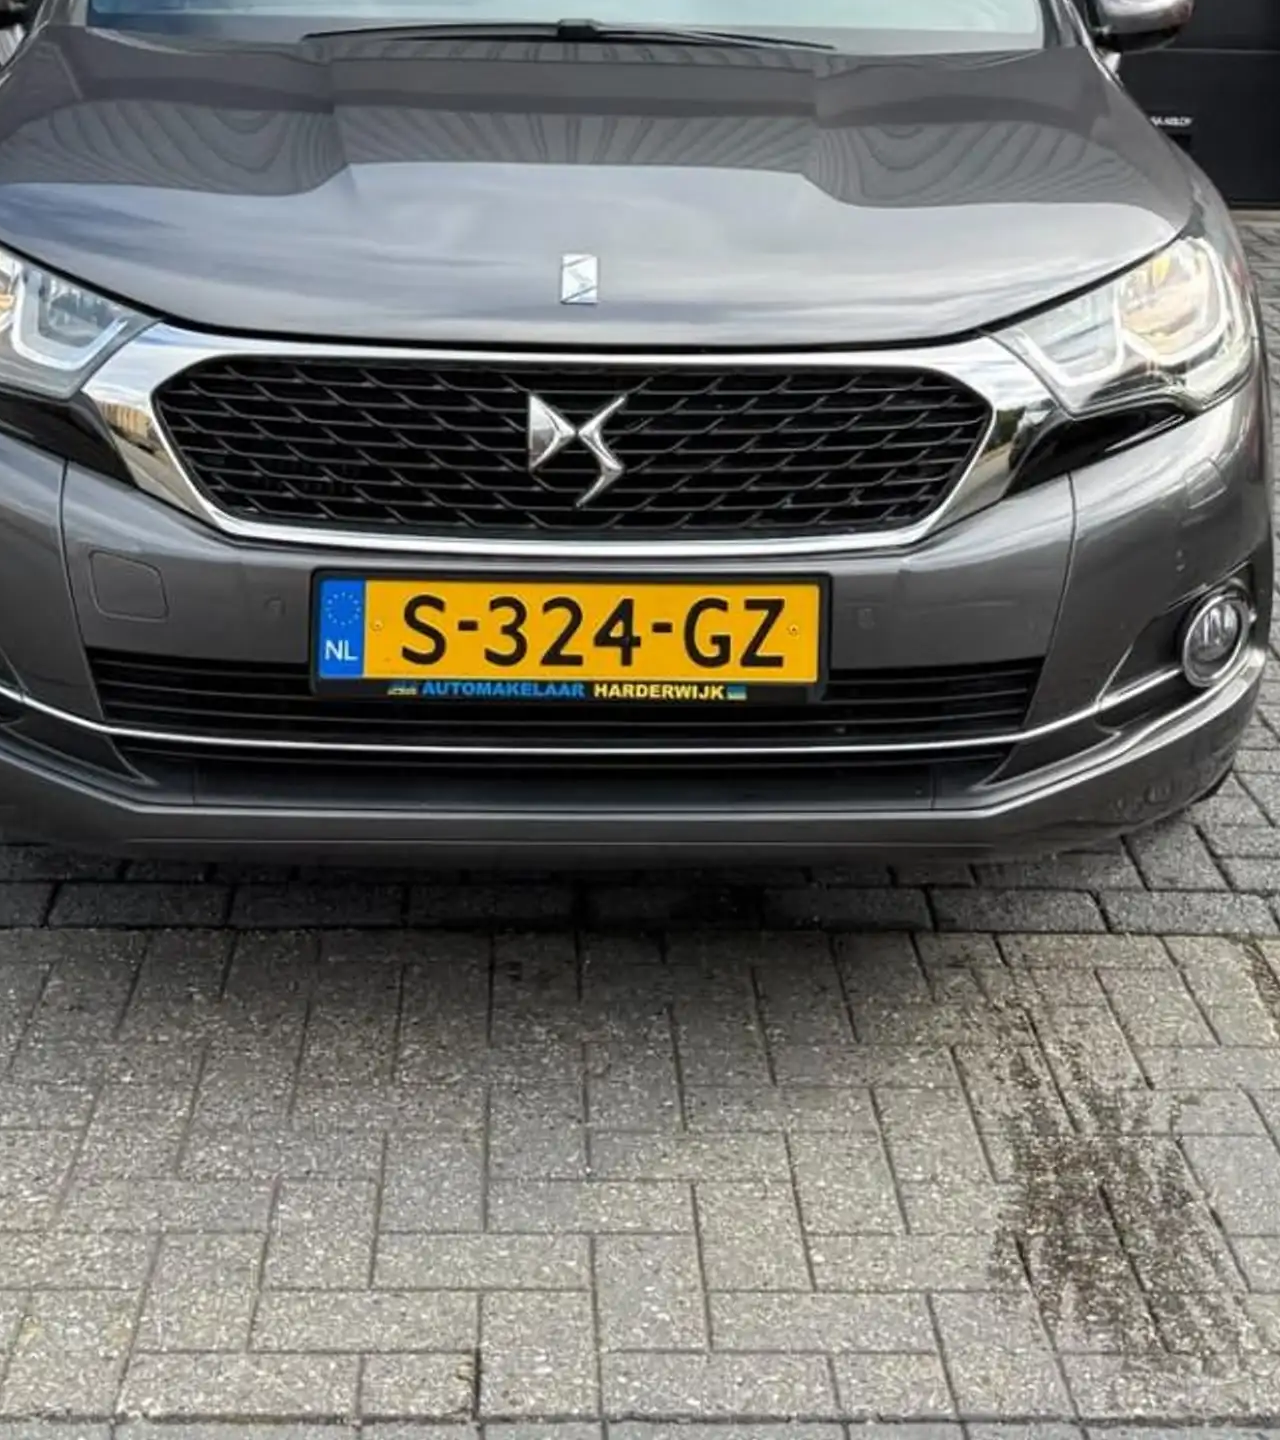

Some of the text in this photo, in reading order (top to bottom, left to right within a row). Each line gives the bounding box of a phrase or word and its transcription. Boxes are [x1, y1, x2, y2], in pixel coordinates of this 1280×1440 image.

[324, 594, 786, 669] NL S-324-GZ
[422, 681, 585, 698] AUTOMAKELAAR
[593, 683, 724, 701] HARDERWIJK
